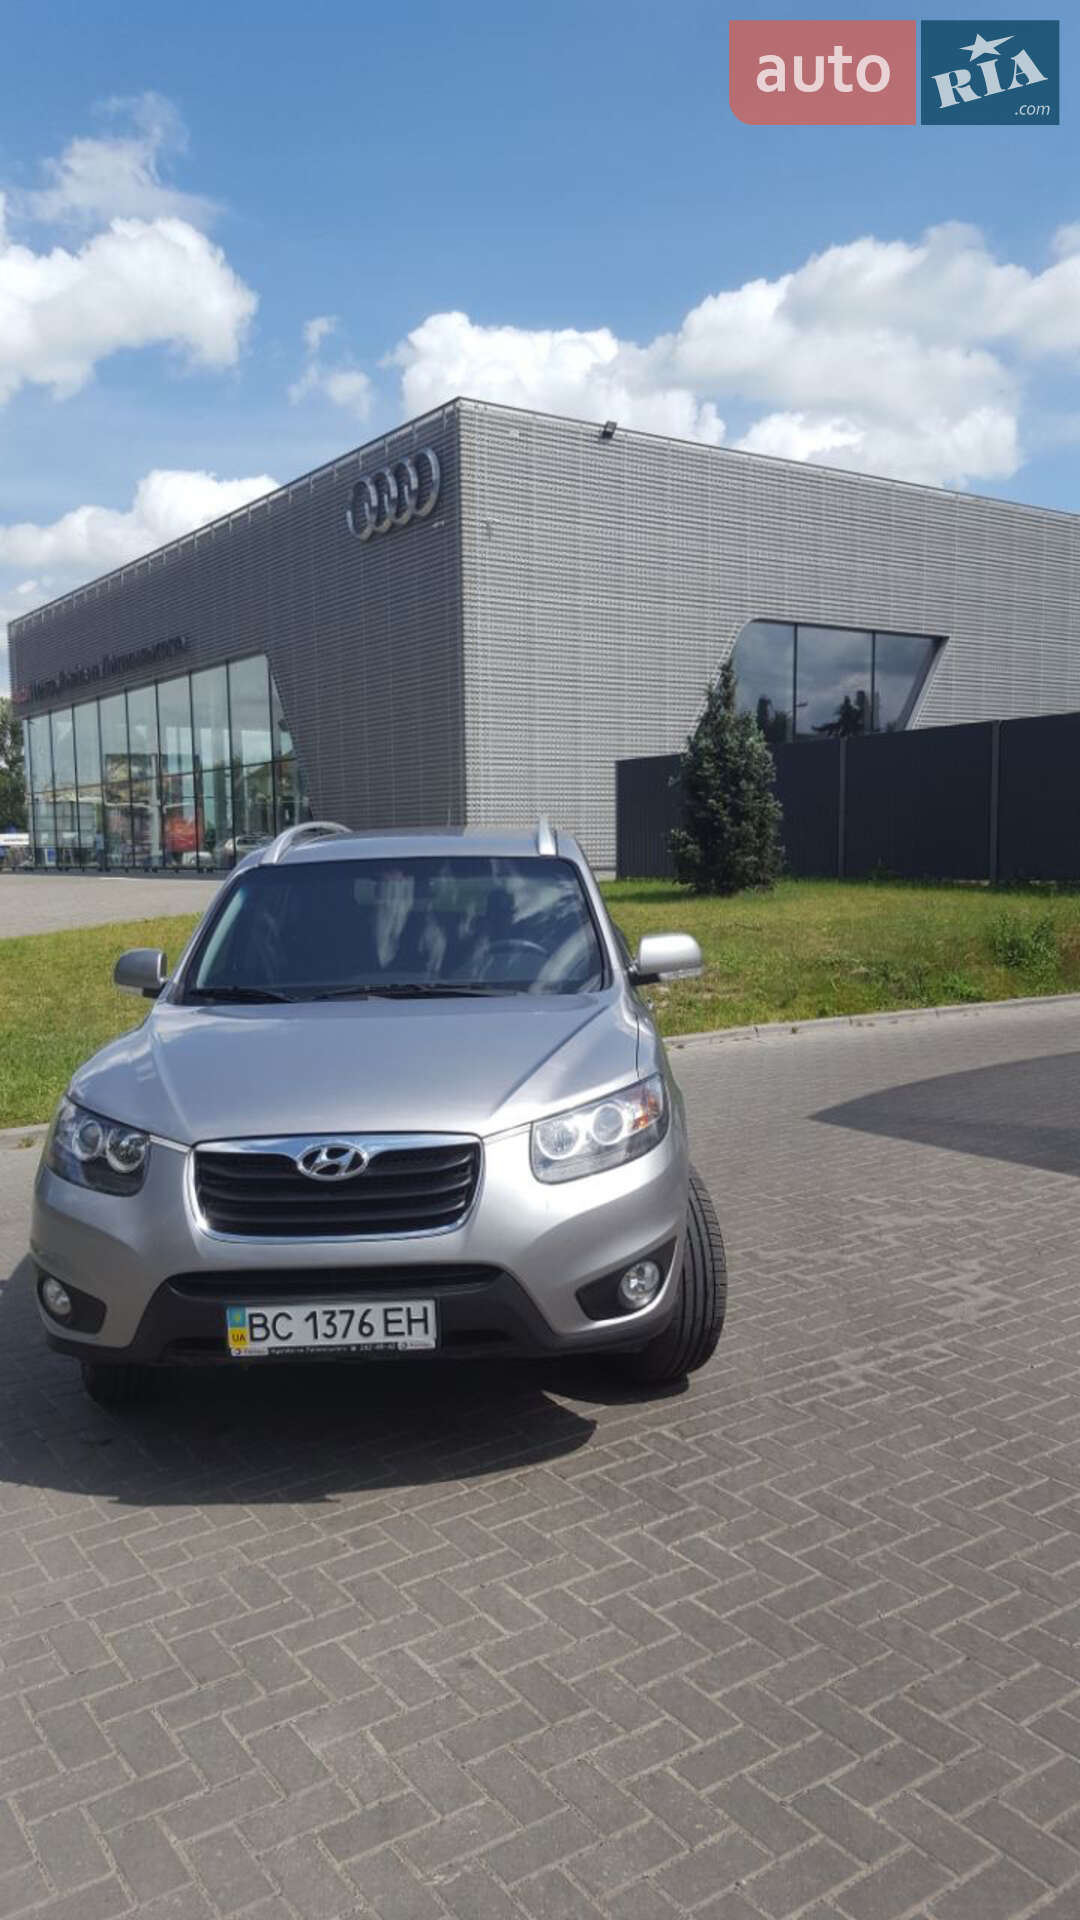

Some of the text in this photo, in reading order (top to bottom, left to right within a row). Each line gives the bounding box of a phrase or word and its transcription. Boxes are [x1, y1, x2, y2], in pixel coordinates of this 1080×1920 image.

[248, 1305, 429, 1342] BC 1376 EH
[231, 1333, 246, 1343] UA
